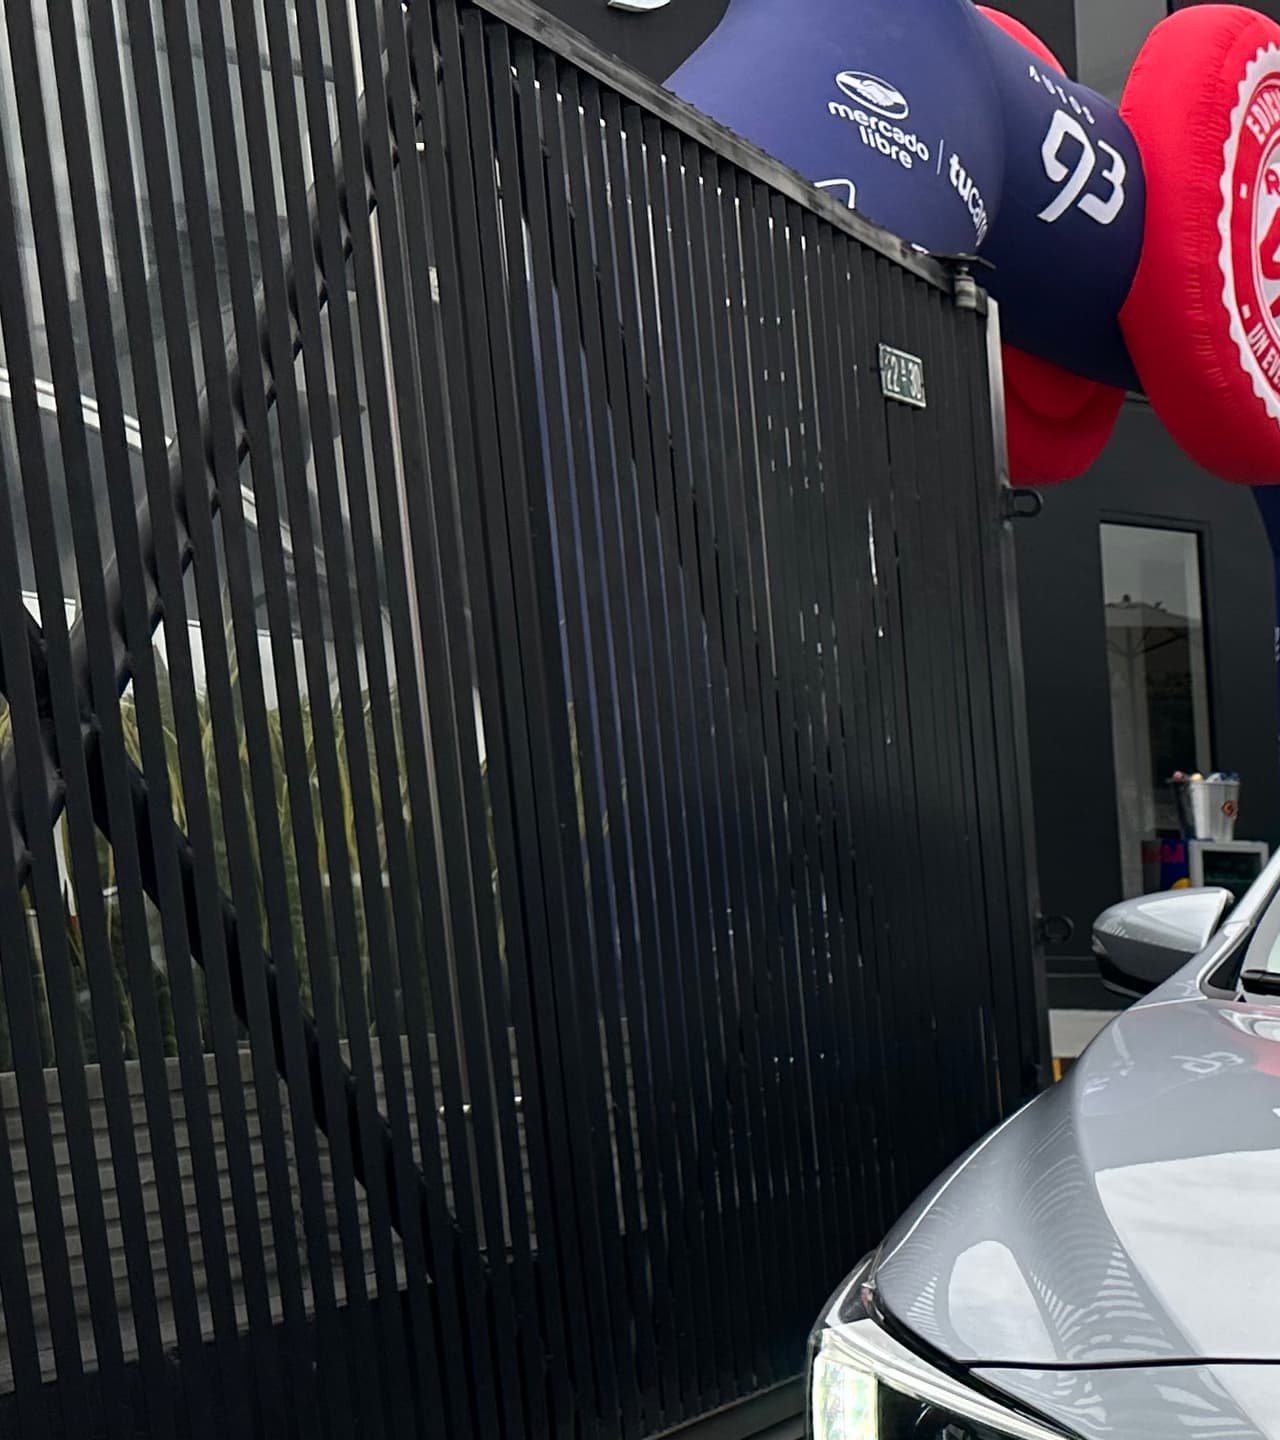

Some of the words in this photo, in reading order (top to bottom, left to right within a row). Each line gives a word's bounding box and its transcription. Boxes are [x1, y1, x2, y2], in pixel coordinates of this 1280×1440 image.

[828, 101, 929, 161] mercado
[859, 125, 912, 169] libre
[1037, 109, 1126, 224] 93
